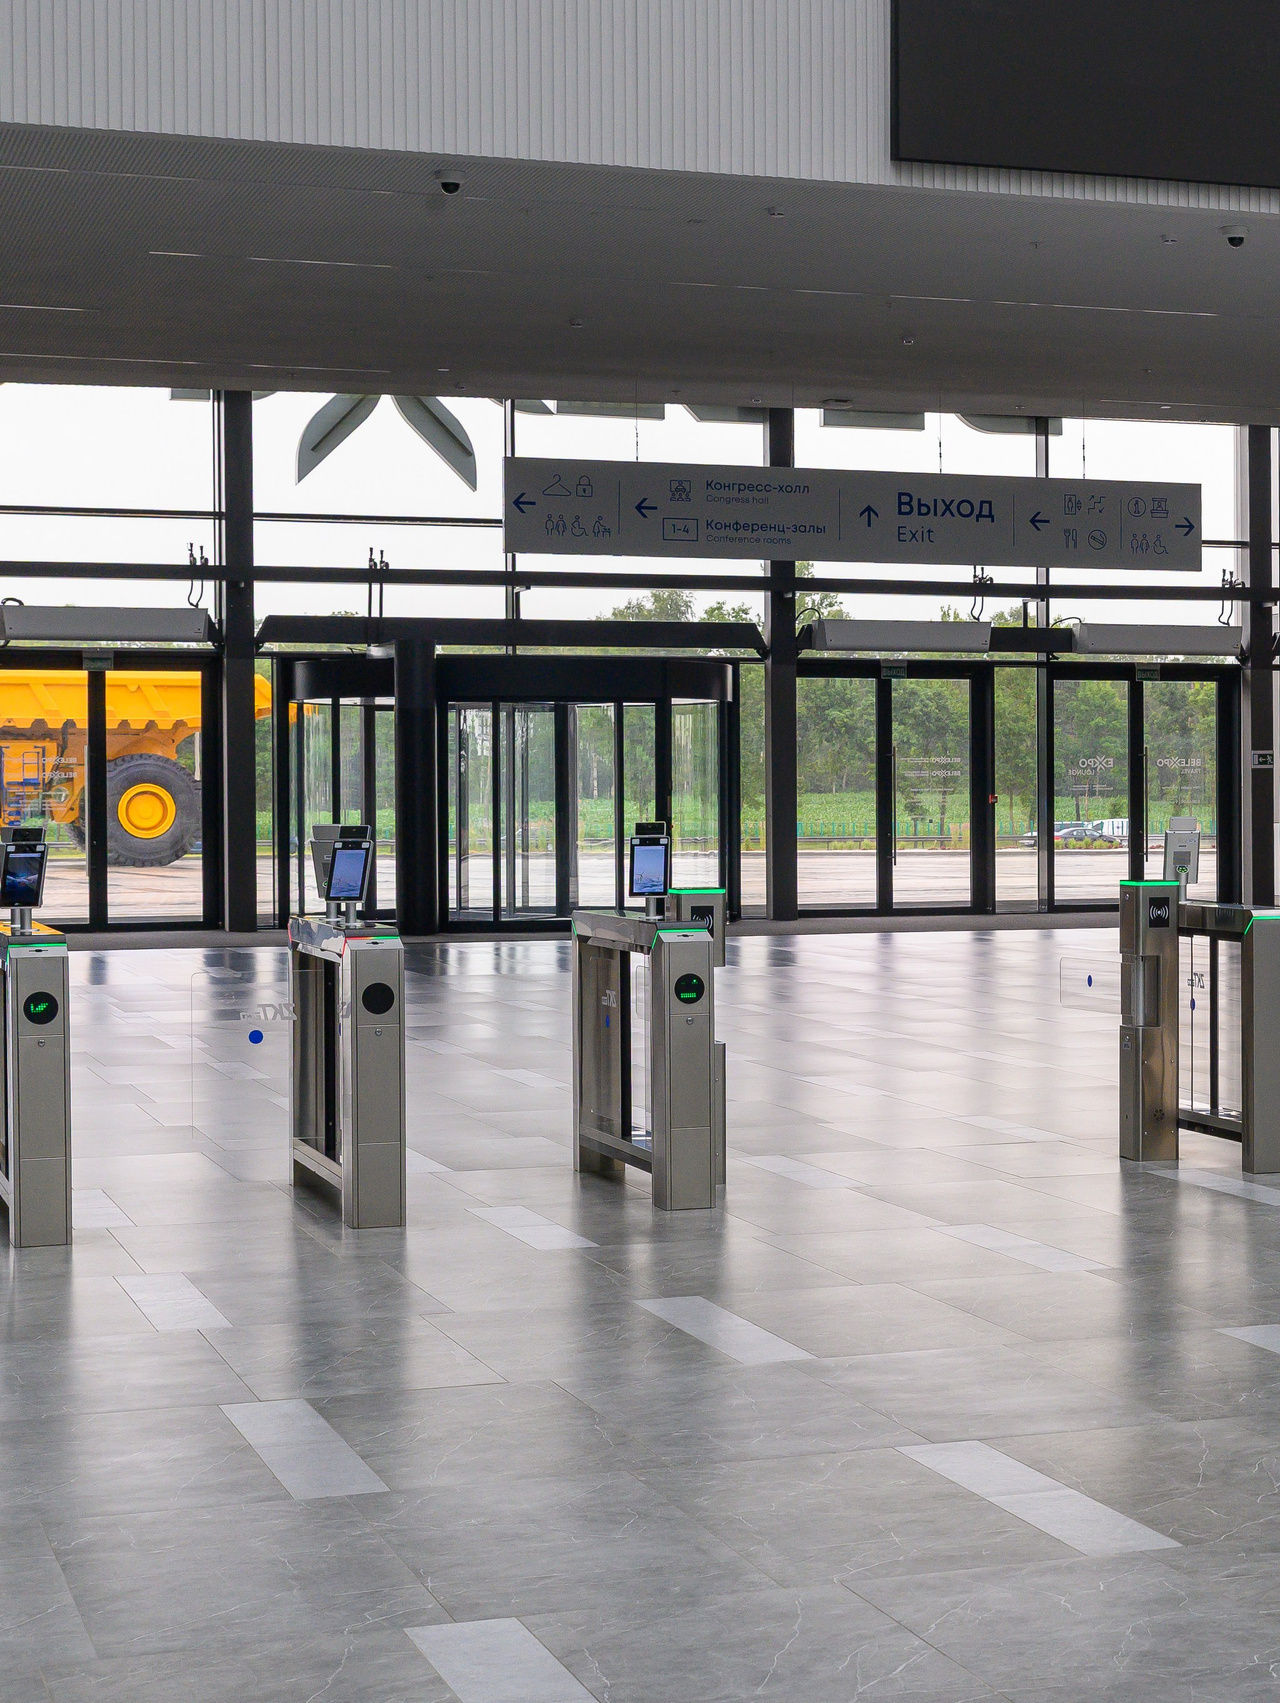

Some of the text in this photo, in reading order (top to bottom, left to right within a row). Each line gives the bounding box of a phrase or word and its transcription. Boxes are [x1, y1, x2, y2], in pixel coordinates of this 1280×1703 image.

[705, 479, 810, 494] Конгресс-холл
[706, 494, 769, 505] Congress hall
[897, 491, 995, 523] Выход
[671, 523, 690, 534] 1-4
[705, 519, 826, 534] Конференц-залы
[706, 534, 792, 545] Conference rooms
[897, 526, 935, 543] Exit
